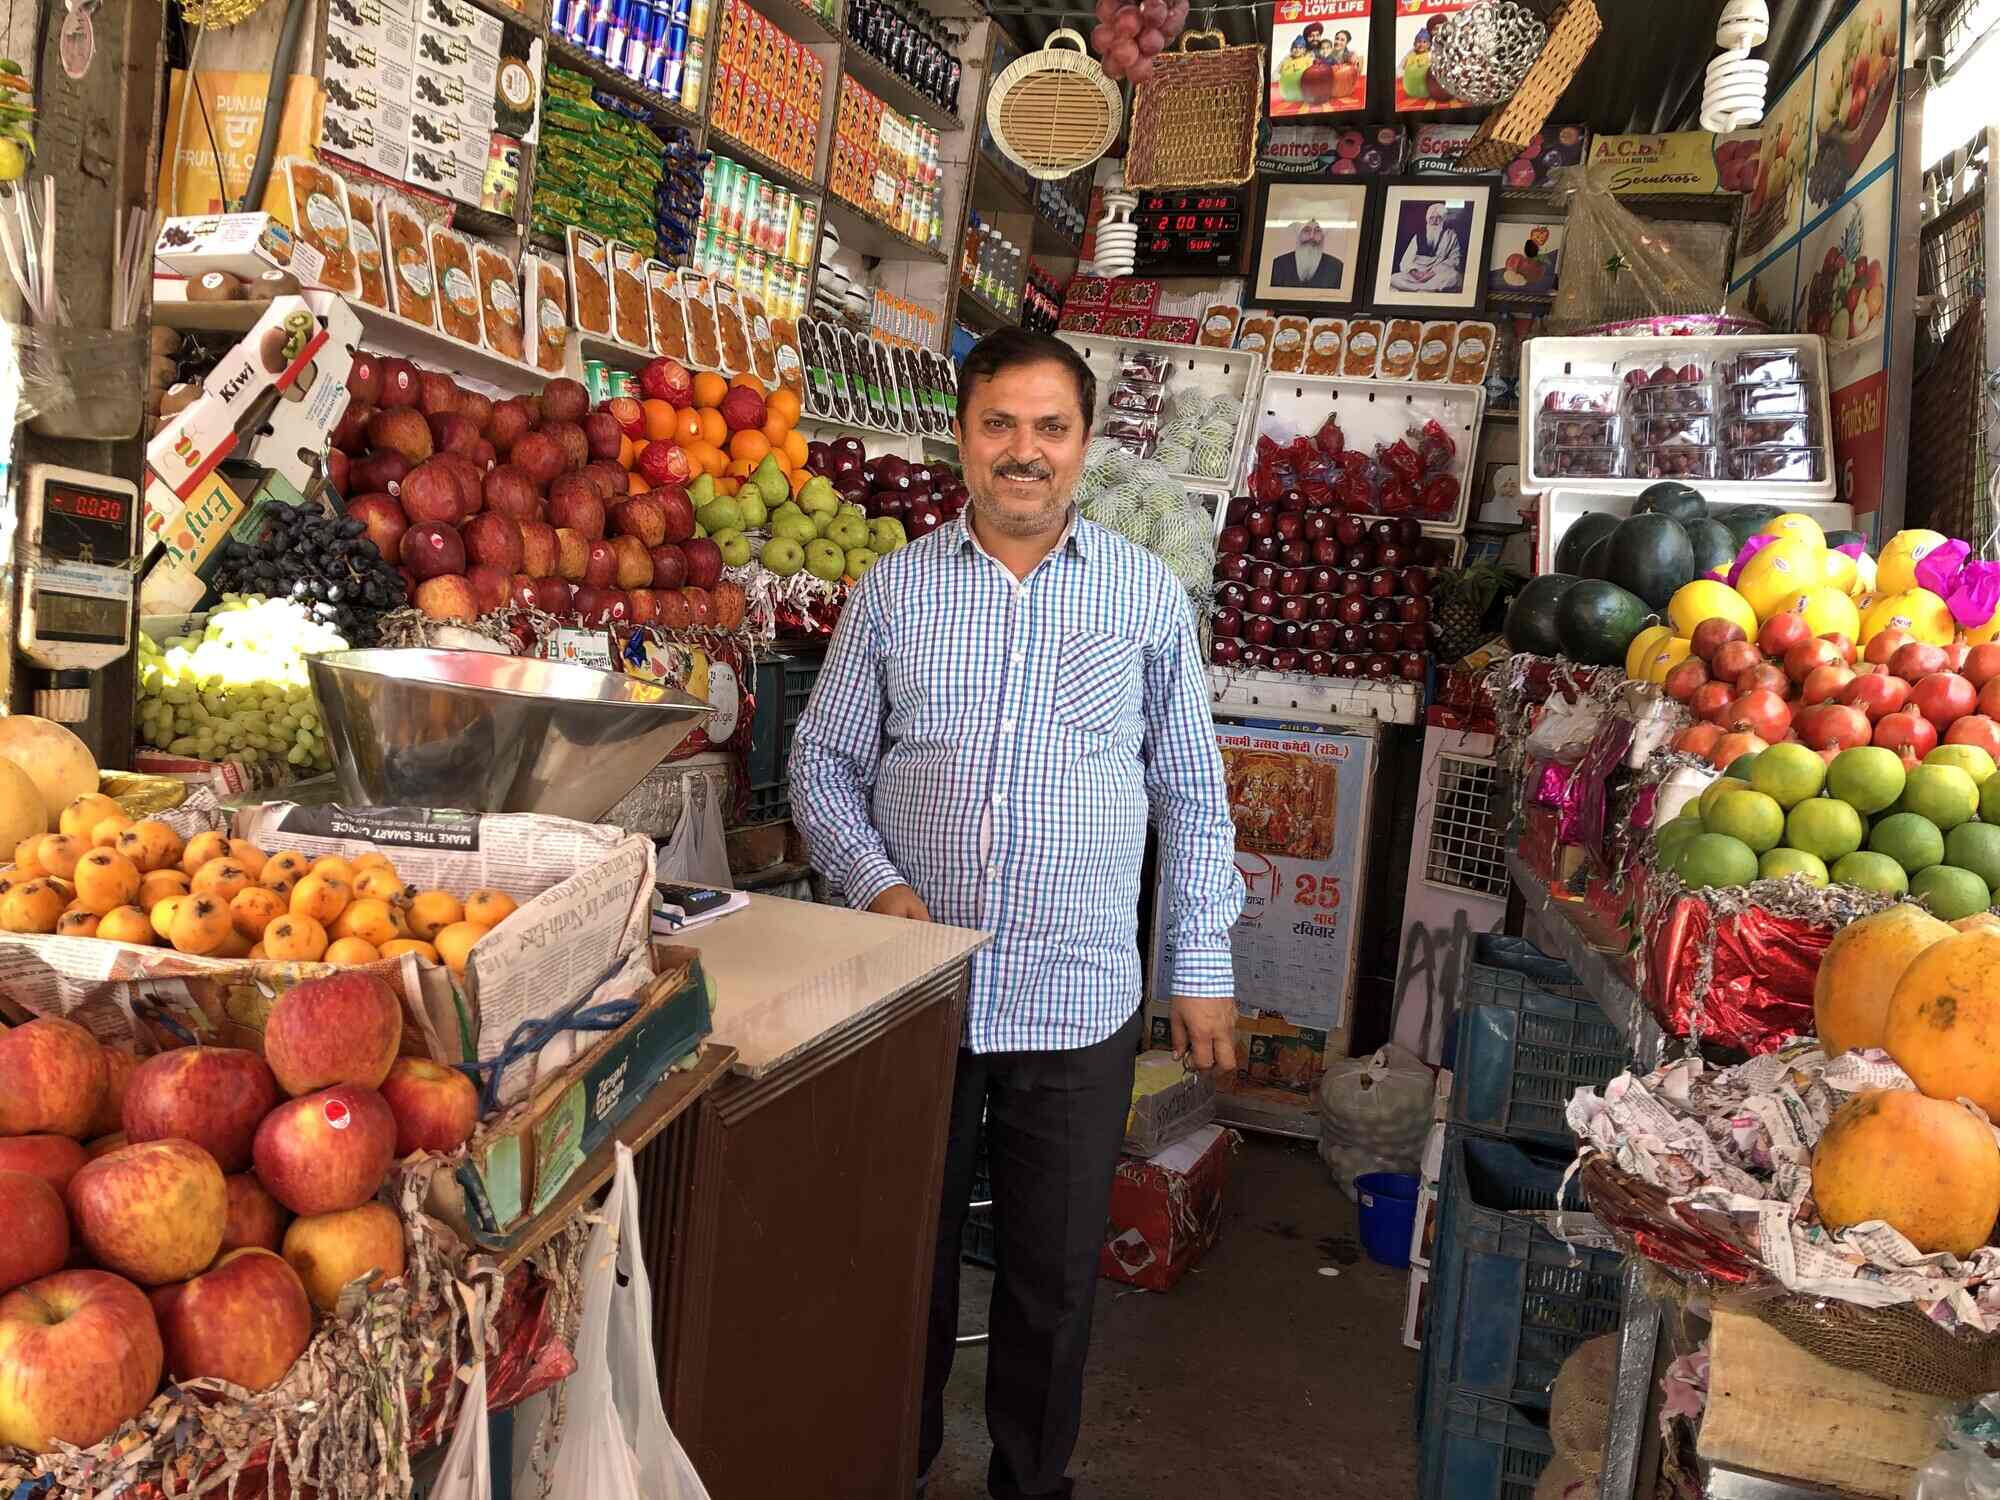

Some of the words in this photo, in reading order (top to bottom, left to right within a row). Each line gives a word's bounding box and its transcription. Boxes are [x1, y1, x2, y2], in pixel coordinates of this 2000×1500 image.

[1304, 3, 1337, 17] LOVE
[1338, 1, 1365, 13] LIFE
[216, 95, 267, 112] PUNJA
[1256, 159, 1277, 169] rom
[218, 361, 256, 404] Kiwi
[330, 821, 370, 835] COICE.
[372, 828, 412, 841] SMART
[414, 831, 435, 842] THE
[439, 832, 471, 845] MAKE
[1295, 873, 1341, 909] 25
[1312, 911, 1337, 925] मार्च
[1292, 919, 1337, 940] रविवार
